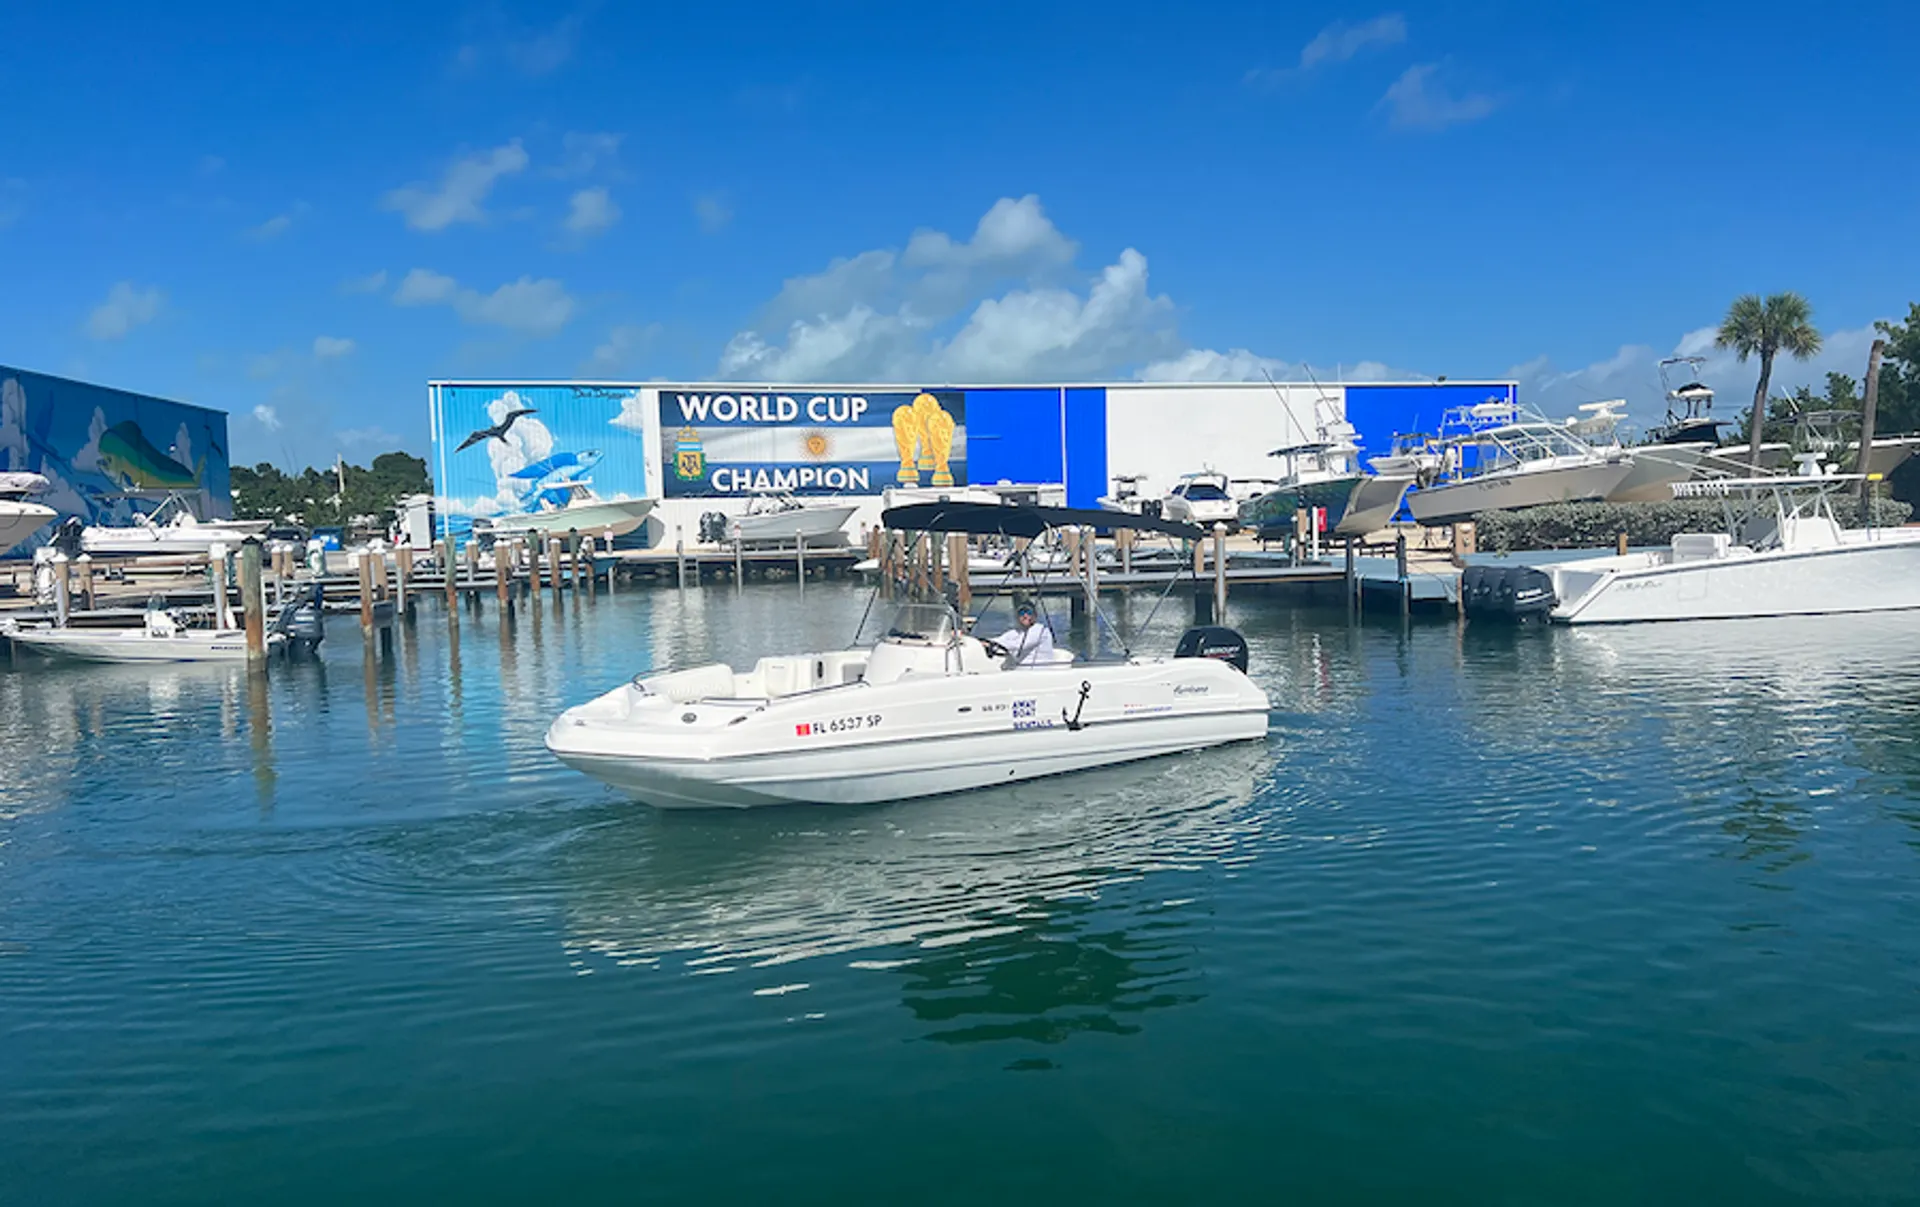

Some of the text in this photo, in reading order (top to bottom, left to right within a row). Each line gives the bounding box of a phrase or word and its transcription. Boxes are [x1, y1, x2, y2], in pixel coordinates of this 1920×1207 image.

[677, 395, 868, 422] WORLD CUP
[711, 467, 870, 492] CHAMPION
[813, 722, 827, 735] FL
[867, 714, 883, 728] SP
[1012, 708, 1037, 719] BOAT
